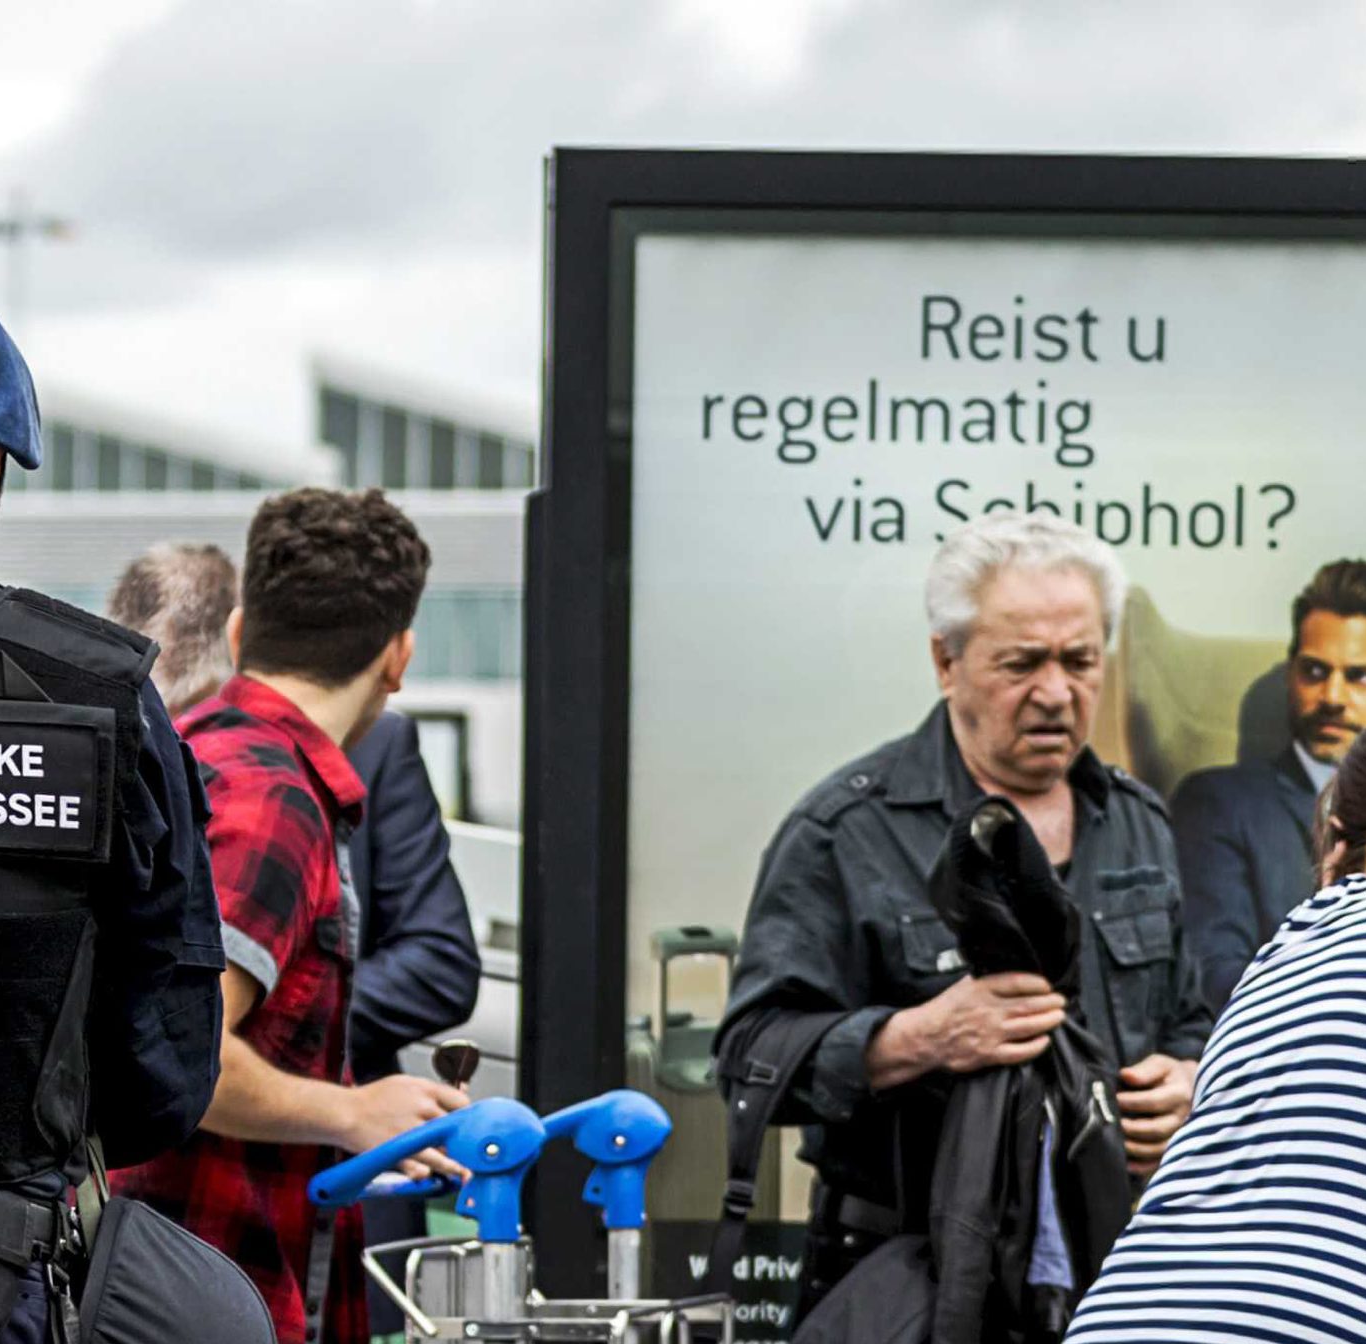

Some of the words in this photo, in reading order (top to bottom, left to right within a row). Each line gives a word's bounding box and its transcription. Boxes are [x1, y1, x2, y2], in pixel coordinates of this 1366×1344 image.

[919, 295, 1099, 362] Reist
[1126, 315, 1167, 362] u
[701, 378, 1096, 469] regelmatig
[804, 477, 906, 543] via
[688, 1254, 750, 1280] Wd
